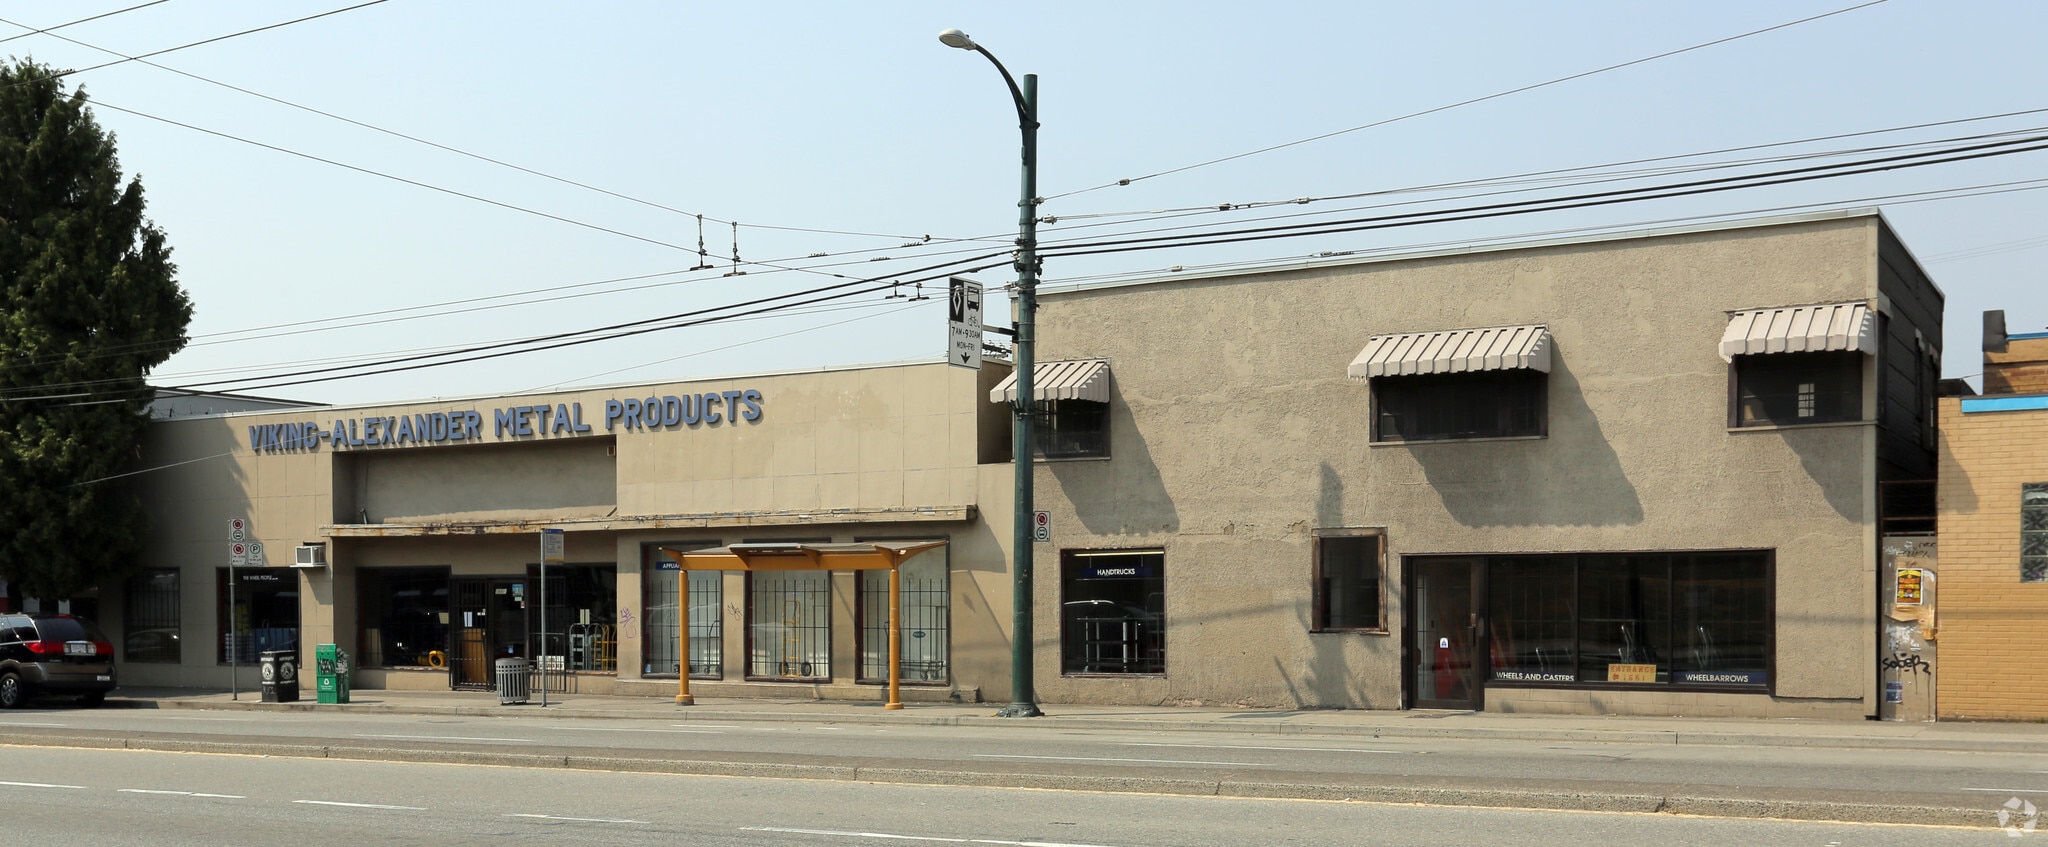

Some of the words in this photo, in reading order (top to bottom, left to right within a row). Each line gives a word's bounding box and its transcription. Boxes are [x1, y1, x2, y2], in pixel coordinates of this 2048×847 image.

[248, 410, 481, 450] VIKING-ALEXANDER
[494, 402, 590, 437] METAL
[605, 389, 761, 429] PRODUCTS
[1096, 568, 1136, 576] HANDTRUCKS
[1685, 673, 1749, 683] WHEELBARROWS
